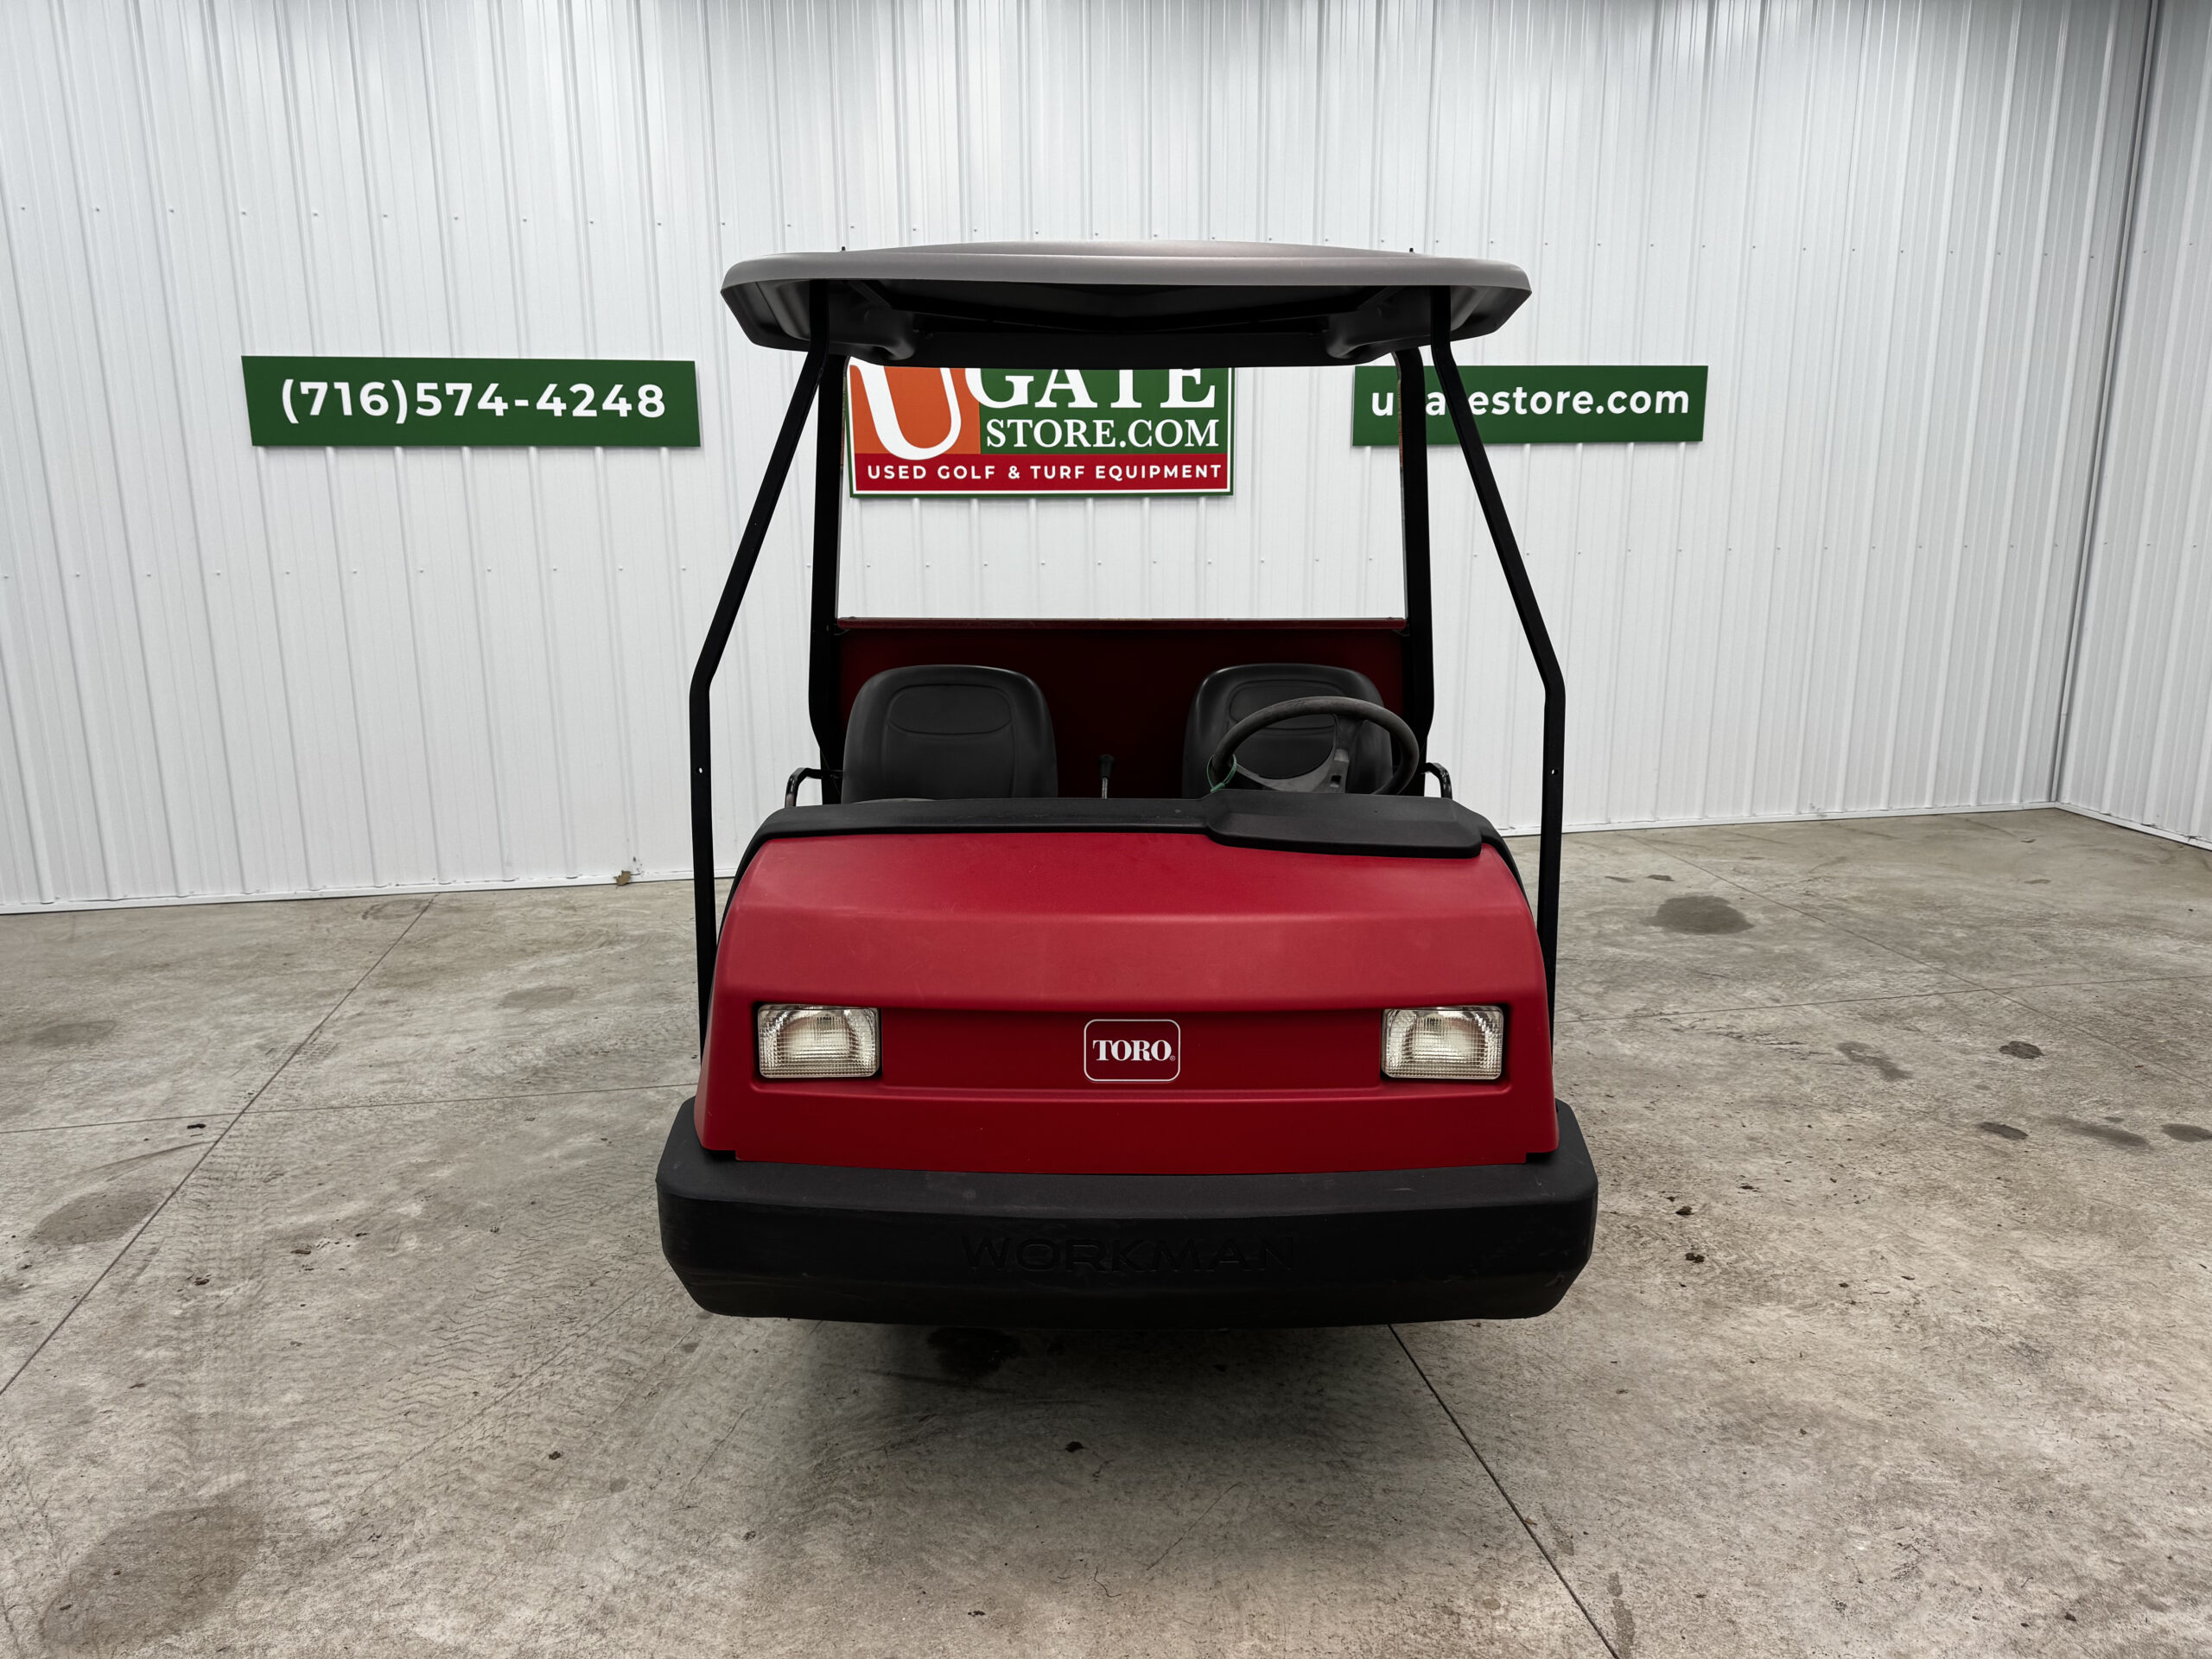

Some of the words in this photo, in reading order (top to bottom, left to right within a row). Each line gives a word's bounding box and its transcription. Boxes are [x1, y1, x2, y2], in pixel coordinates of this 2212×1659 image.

[282, 378, 665, 424] (716)574-4248
[1371, 385, 1689, 416] uaestore.com
[986, 418, 1219, 448] STORE.COM
[868, 465, 927, 480] USED
[937, 465, 995, 480] GOLF
[1007, 465, 1020, 480] &
[1029, 465, 1085, 480] TURF
[1095, 464, 1222, 482] EQUIPMENT
[961, 1236, 1294, 1273] WORKMAN
